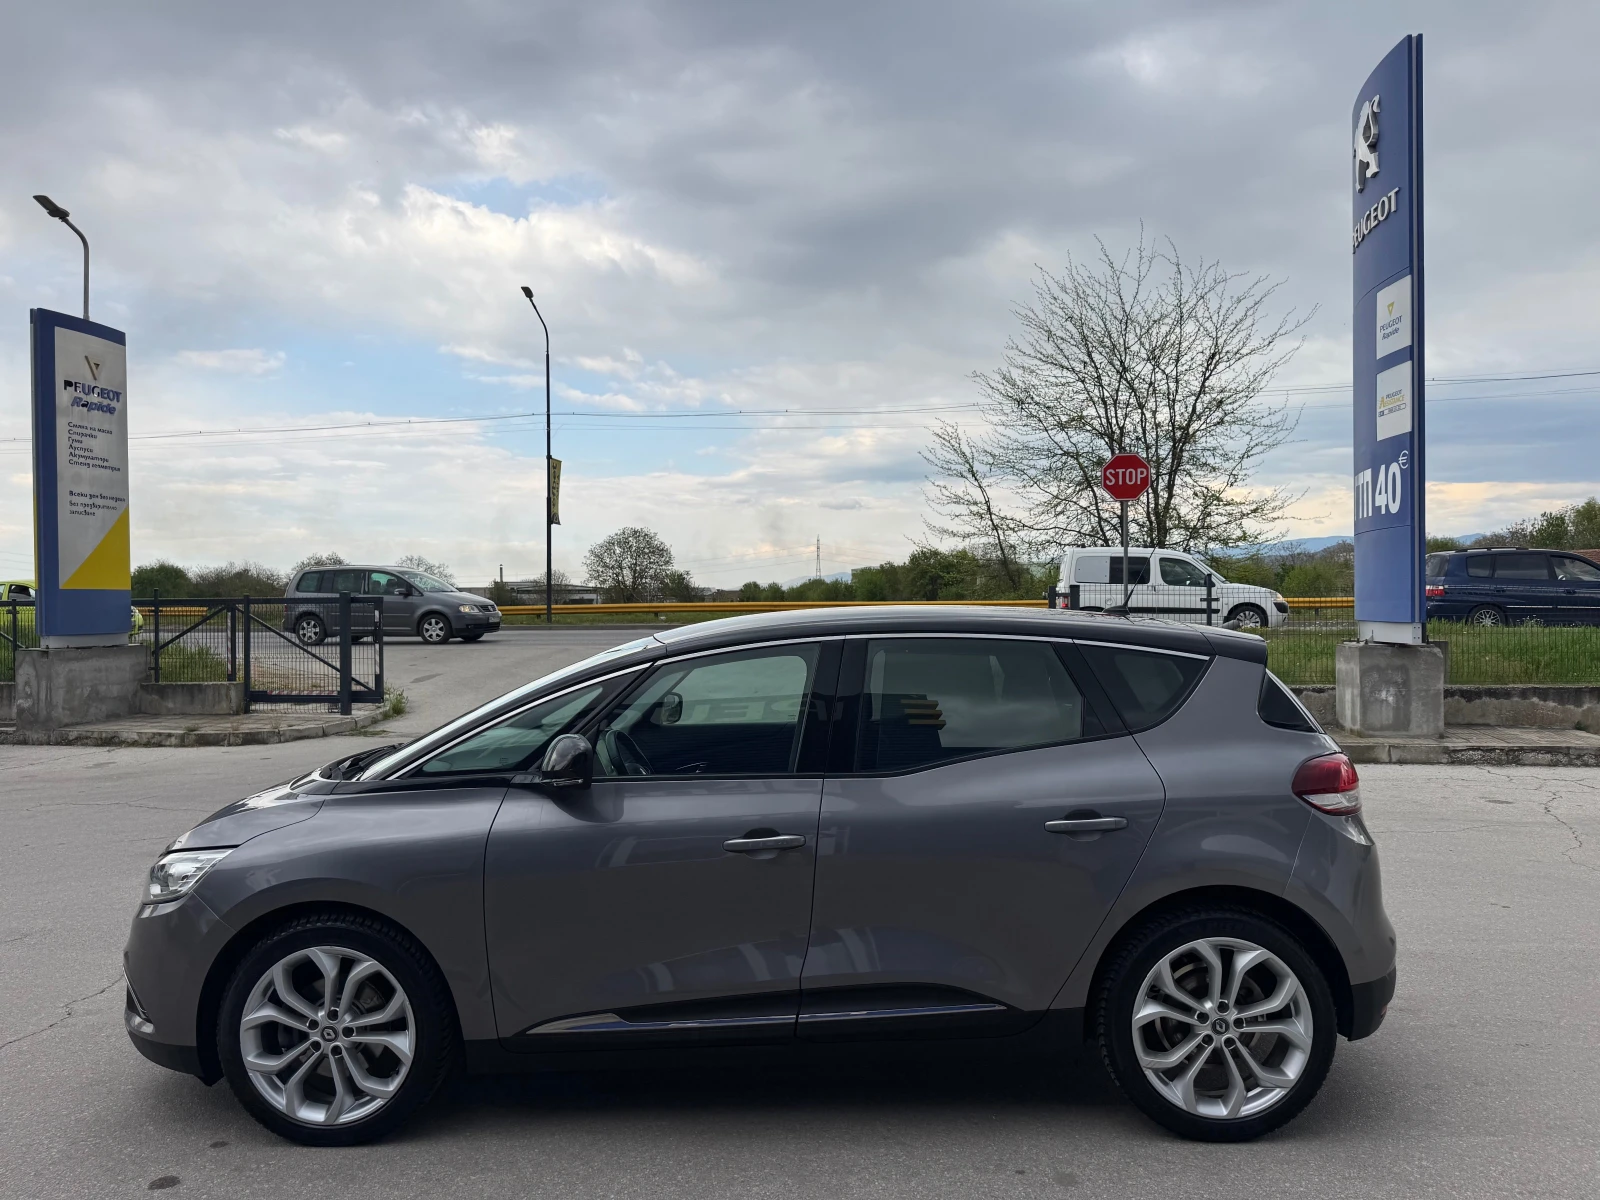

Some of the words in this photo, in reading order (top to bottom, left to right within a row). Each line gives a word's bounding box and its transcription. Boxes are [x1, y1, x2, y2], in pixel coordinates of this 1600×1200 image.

[1380, 315, 1402, 333] PEUGEOT
[64, 380, 122, 403] PEUGEOT
[71, 396, 116, 415] Rapide
[68, 421, 88, 431] Смяна
[68, 429, 97, 439] Спирачки
[68, 436, 83, 444] Гуми
[69, 444, 93, 453] Ауспуси
[69, 452, 109, 463] Акумулатори
[69, 459, 90, 468] Стенд
[1105, 468, 1147, 486] STOP
[69, 490, 87, 498] Всеки
